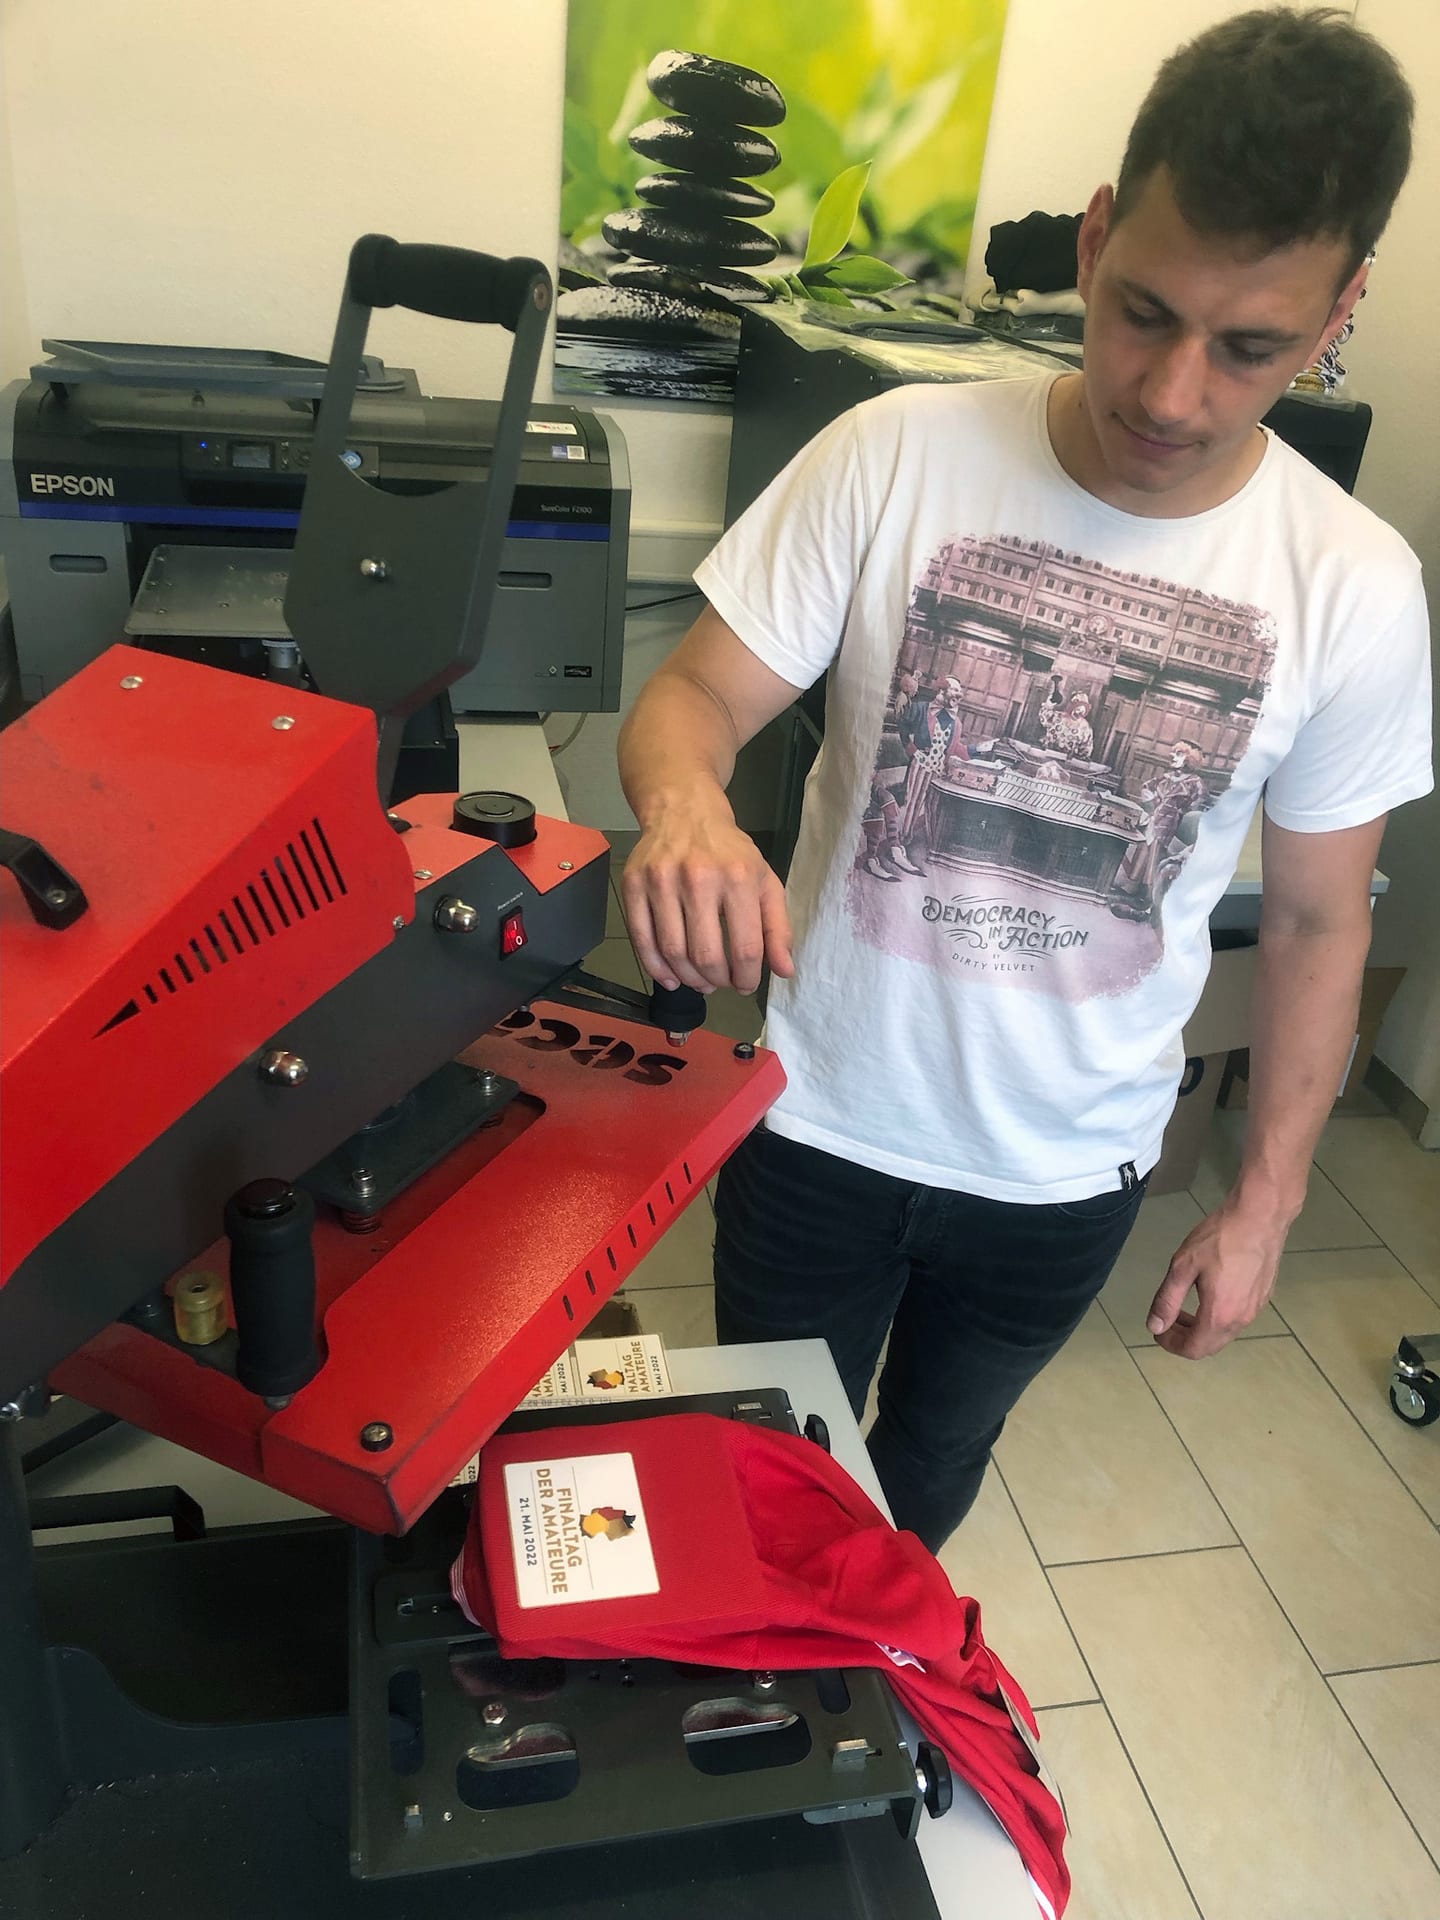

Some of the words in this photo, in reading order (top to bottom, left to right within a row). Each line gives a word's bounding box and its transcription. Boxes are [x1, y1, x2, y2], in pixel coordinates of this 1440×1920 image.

[30, 474, 115, 497] EPSON
[988, 925, 1003, 940] IN
[952, 953, 988, 970] DIRTY
[994, 963, 1036, 972] VELVET
[556, 1363, 566, 1380] 2022
[630, 1340, 652, 1393] AMATEURE
[650, 1355, 660, 1372] 2022
[559, 1381, 568, 1393] MAI
[654, 1374, 663, 1386] MAI
[536, 1468, 554, 1499] DER
[519, 1497, 530, 1512] 21.
[521, 1515, 533, 1535] MAI
[556, 1487, 583, 1568] FINALTAG
[524, 1538, 537, 1566] 2022
[541, 1503, 569, 1594] AMATEURE
